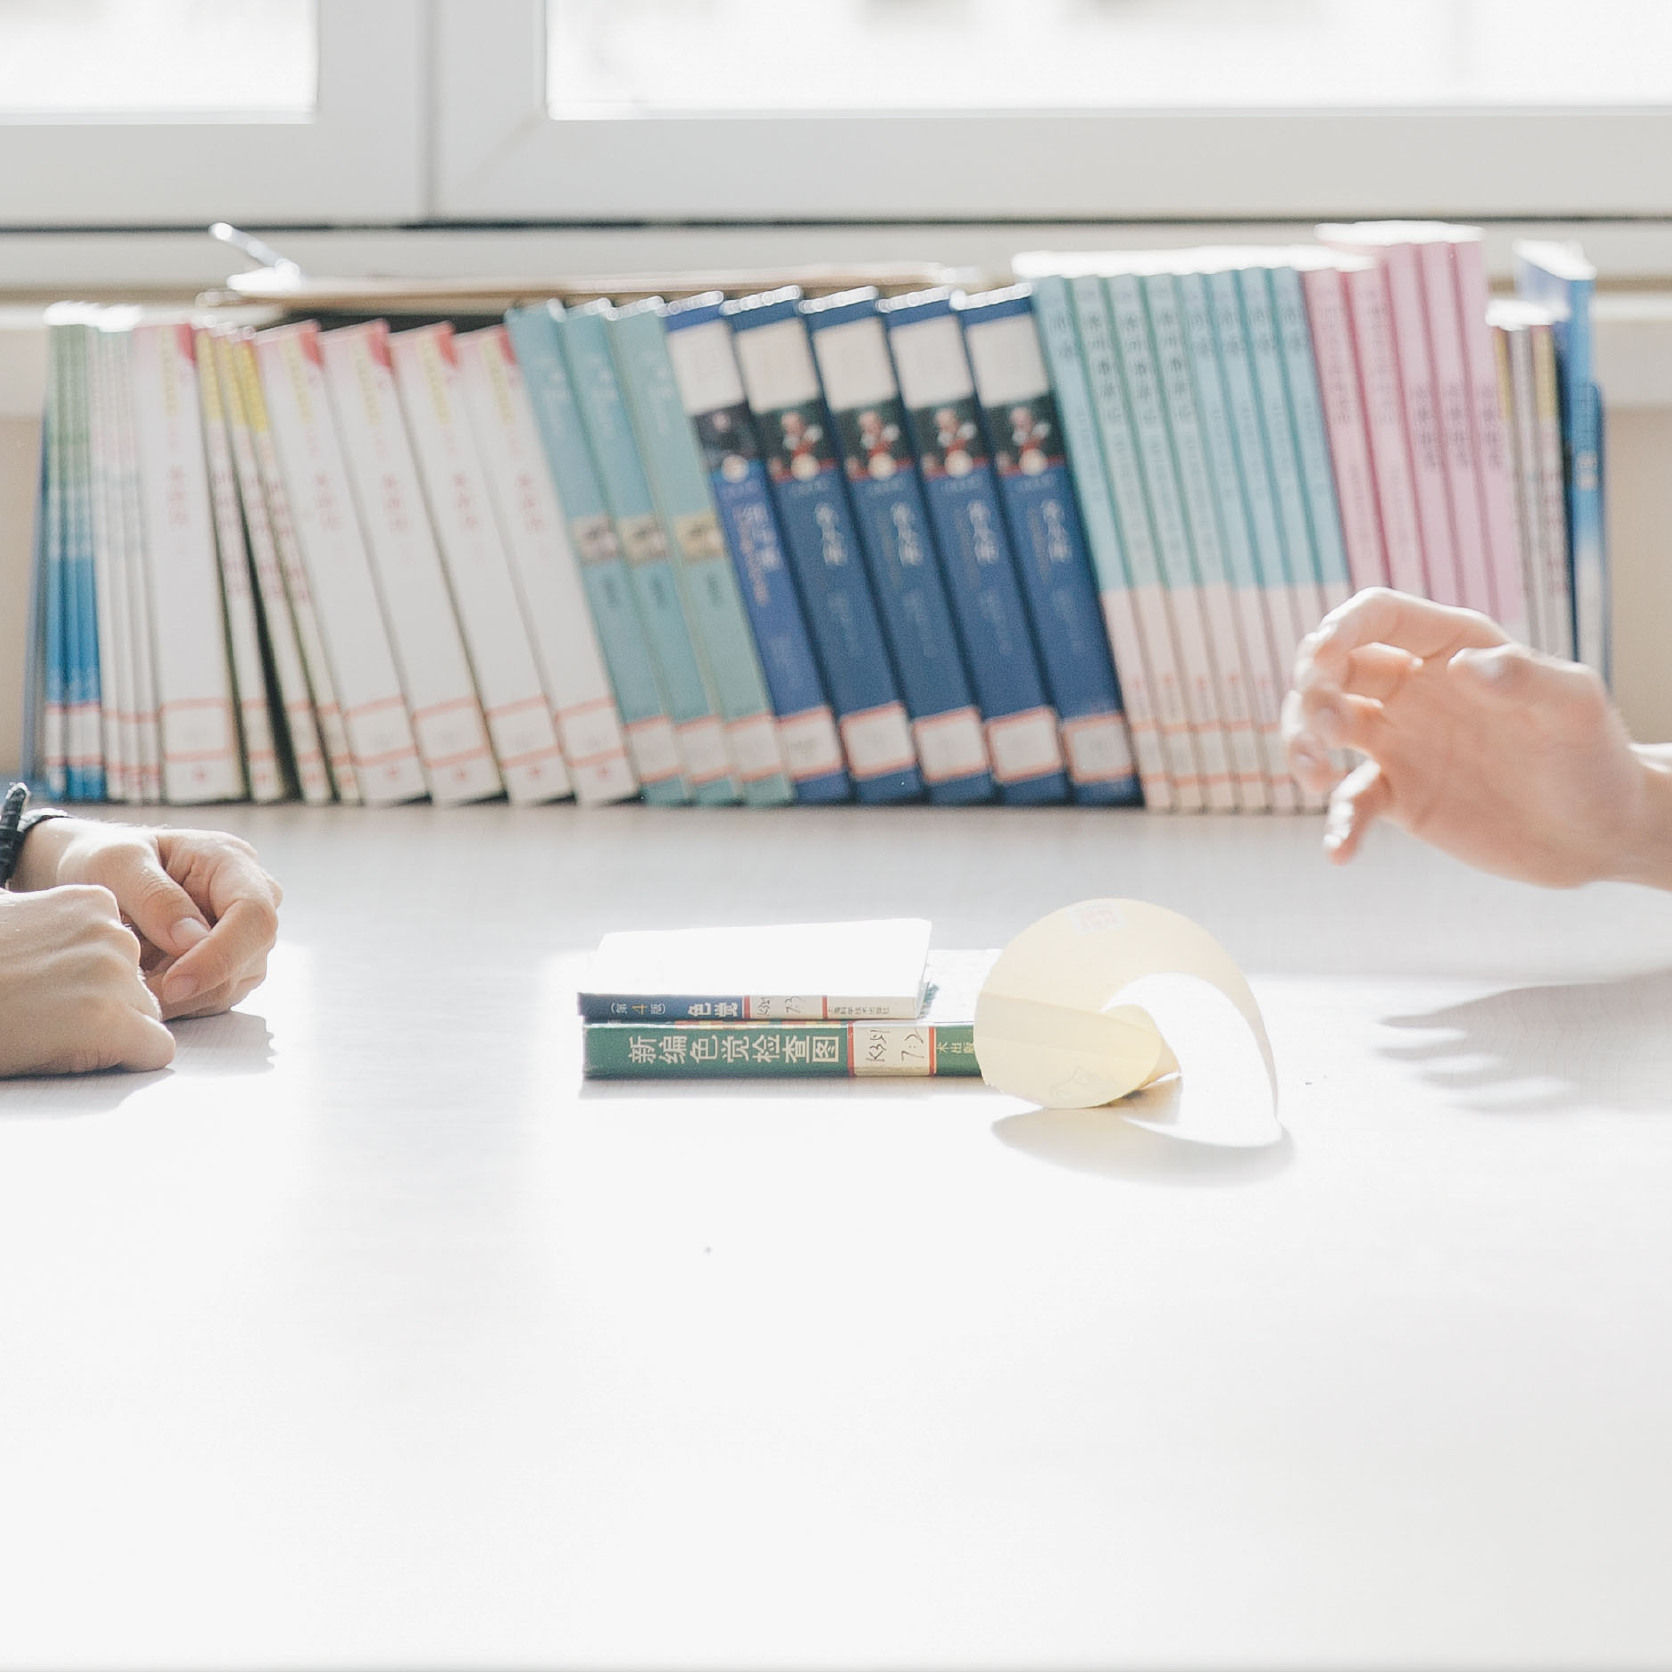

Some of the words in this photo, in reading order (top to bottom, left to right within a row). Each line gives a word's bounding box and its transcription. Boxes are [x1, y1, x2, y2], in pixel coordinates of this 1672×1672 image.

[627, 1033, 840, 1065] 新编色觉检查图
